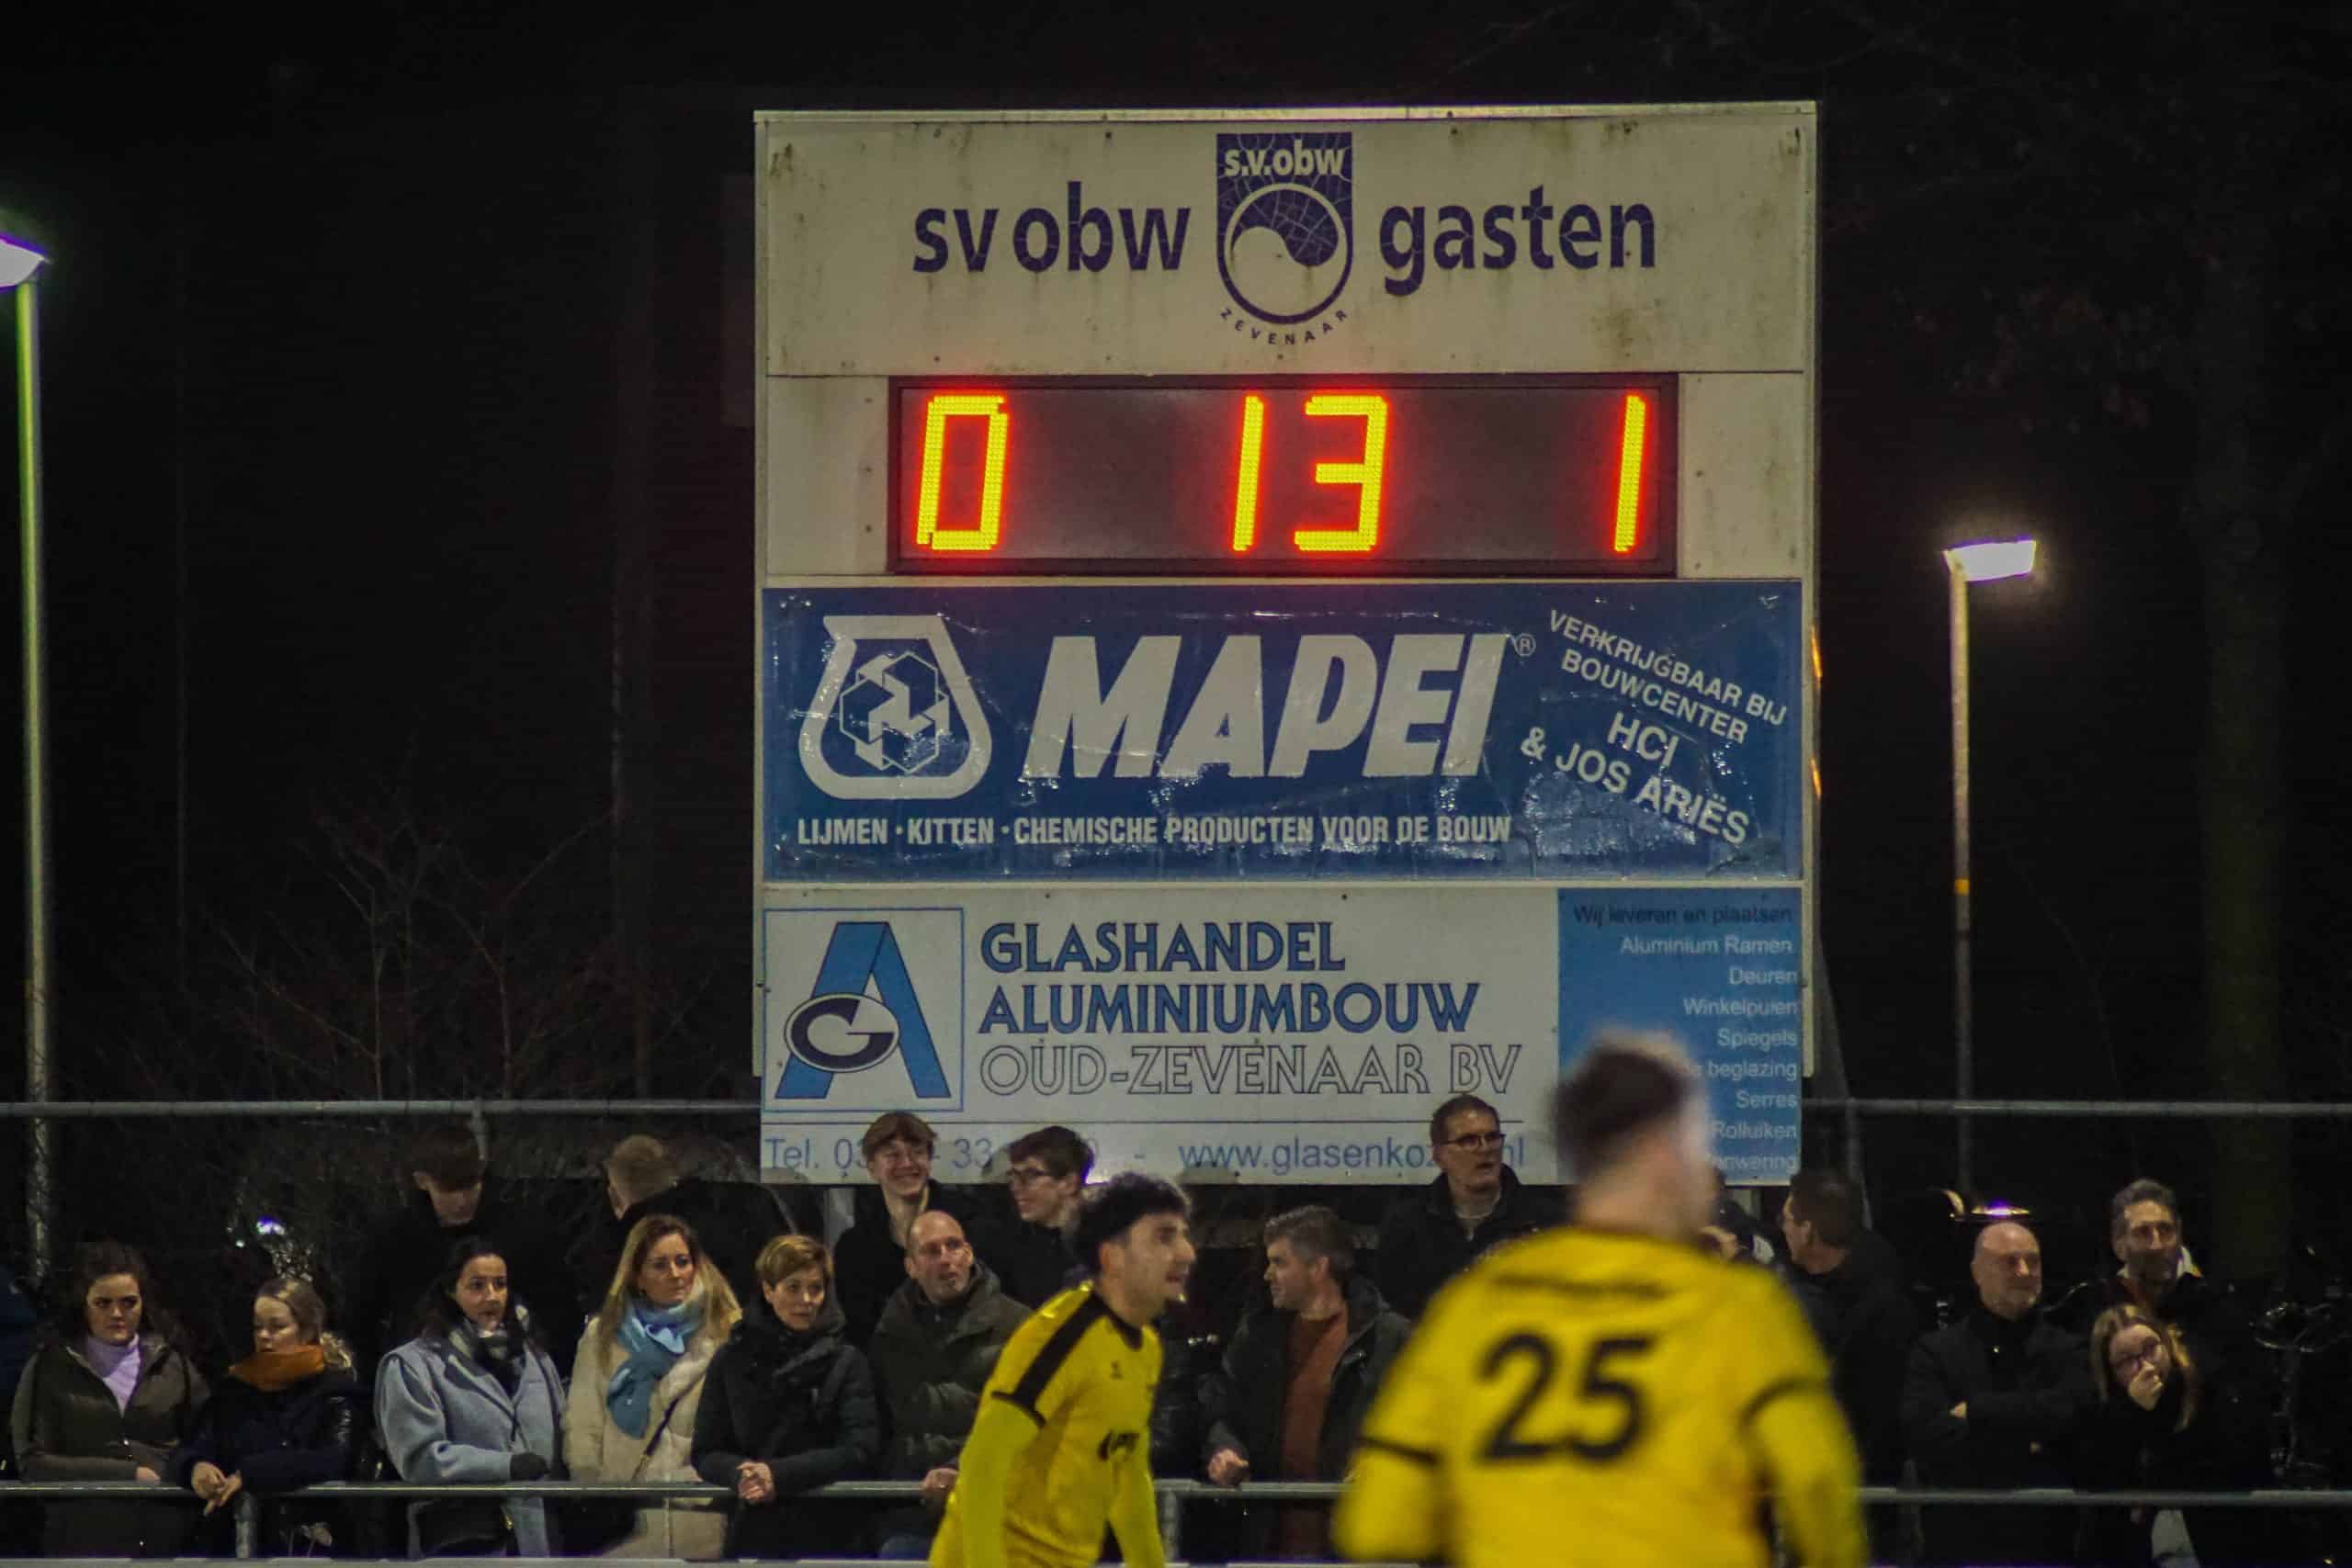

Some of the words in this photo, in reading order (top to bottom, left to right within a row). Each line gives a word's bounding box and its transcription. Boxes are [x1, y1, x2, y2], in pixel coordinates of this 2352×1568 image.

[1224, 139, 1346, 177] s.v.obw
[912, 208, 1001, 273] sv
[1012, 181, 1192, 273] obw
[1380, 185, 1656, 297] gasten
[1219, 309, 1348, 345] ZEVENAAR
[916, 395, 1008, 551] 0
[1233, 395, 1387, 551] 13
[1614, 395, 1646, 552] 1
[1550, 609, 1743, 707] VERKRIJGBAAR
[1746, 694, 1787, 726] BIJ
[1021, 634, 1509, 778] MAPEI
[1562, 649, 1748, 745] BOUWCENTER
[1608, 711, 1679, 768] HCI
[1521, 727, 1547, 761] &
[1555, 742, 1632, 795] JOS
[1634, 774, 1750, 845] ARIËS
[797, 818, 888, 845] LIJMEN
[907, 817, 994, 844] KITTEN
[1014, 817, 1158, 844] CHEMISCHE
[1167, 816, 1314, 844] PRODUCTEN
[1321, 816, 1389, 843] VOOR
[1396, 816, 1430, 843] DE
[1437, 816, 1513, 843] BOUW
[1574, 904, 1603, 930] Wij
[1609, 905, 1676, 924] leveren
[1683, 908, 1706, 924] en
[1712, 905, 1792, 928] plaatsen
[979, 921, 1346, 974] GLASHANDEL
[1620, 934, 1719, 955] Aluminium
[1724, 934, 1793, 954] Ramen
[1728, 966, 1798, 986] Deuren
[978, 982, 1481, 1034] ALUMINIUMBOUW
[1682, 997, 1798, 1019] Winkelpuien
[1717, 1028, 1798, 1051] Spiegels
[979, 1043, 1430, 1096] OUD-ZEVENAAR
[1448, 1043, 1522, 1095] BV
[1707, 1060, 1798, 1082] beglazing
[1736, 1089, 1798, 1109] Serres
[763, 1137, 820, 1170] Tel.
[1475, 1330, 1659, 1464] 25
